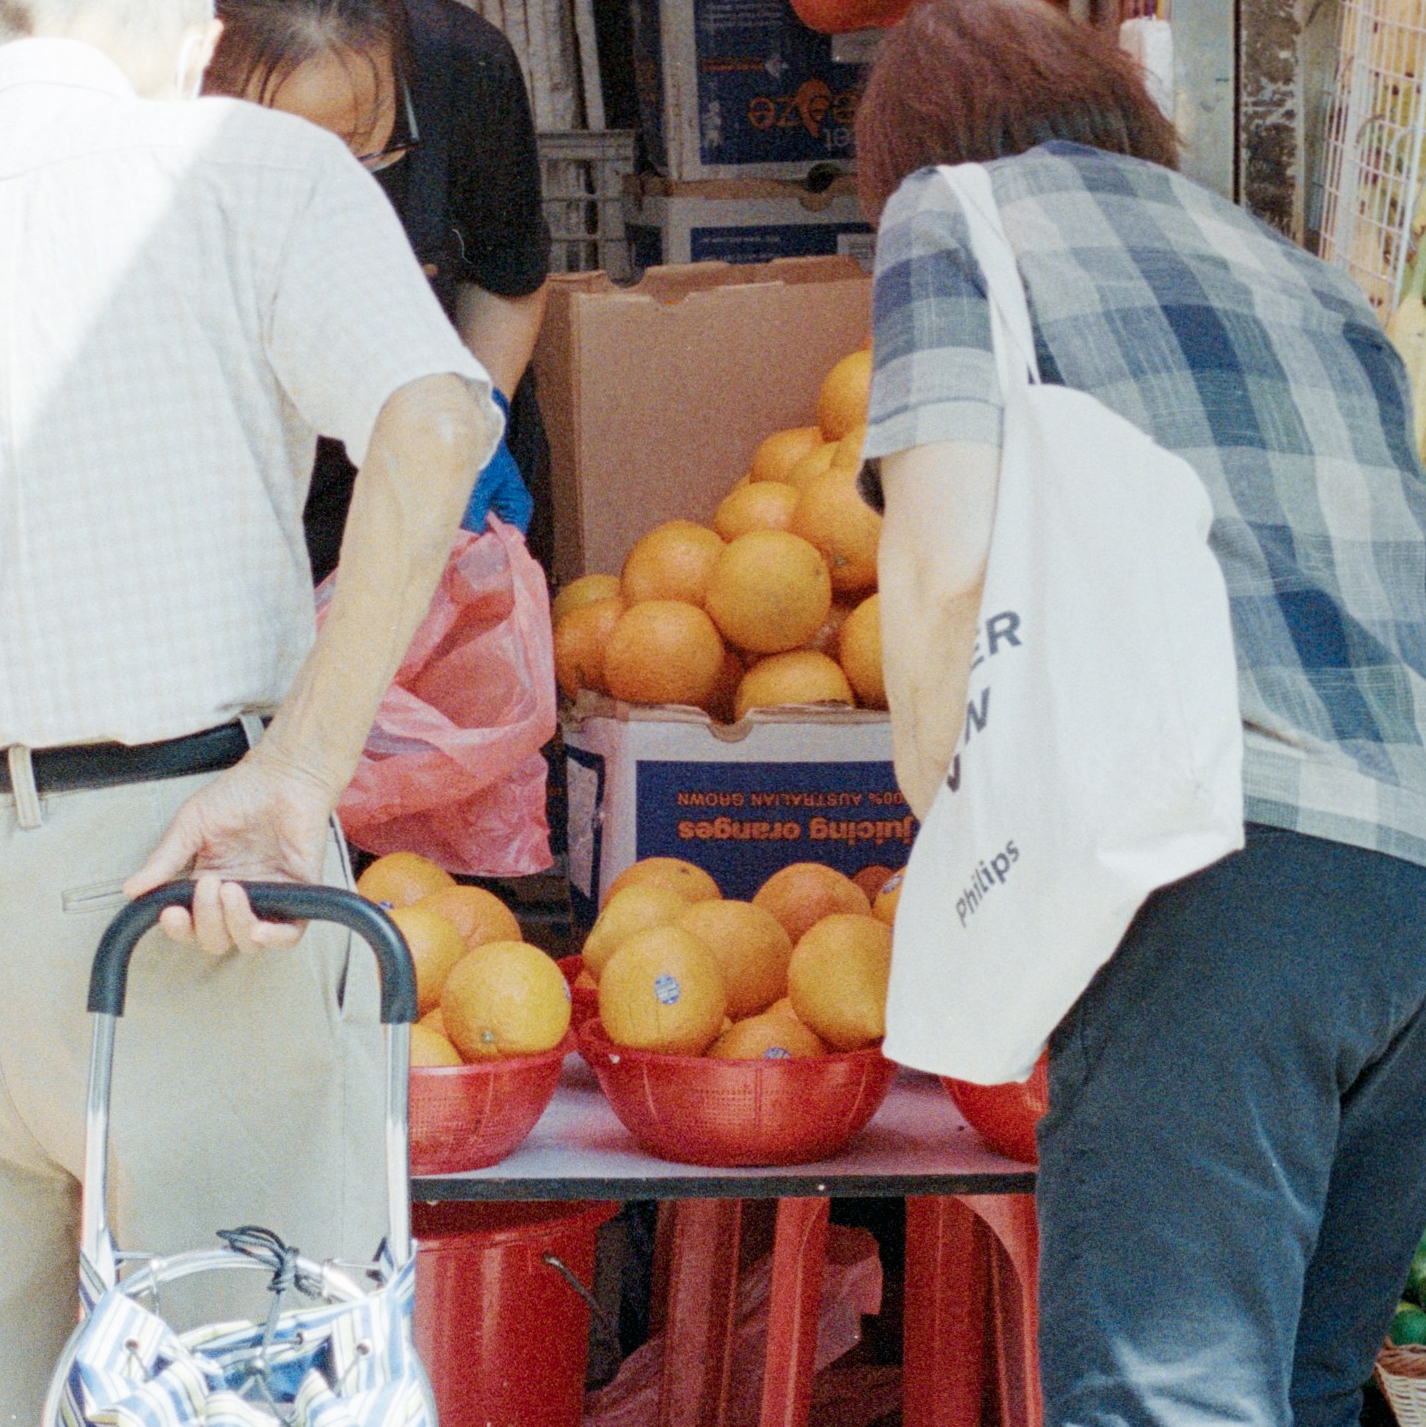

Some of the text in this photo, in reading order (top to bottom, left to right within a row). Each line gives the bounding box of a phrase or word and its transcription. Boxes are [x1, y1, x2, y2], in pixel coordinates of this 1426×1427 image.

[677, 791, 905, 807] 00% AUSTRALIAN GROWN
[677, 816, 914, 846] juicing oranges
